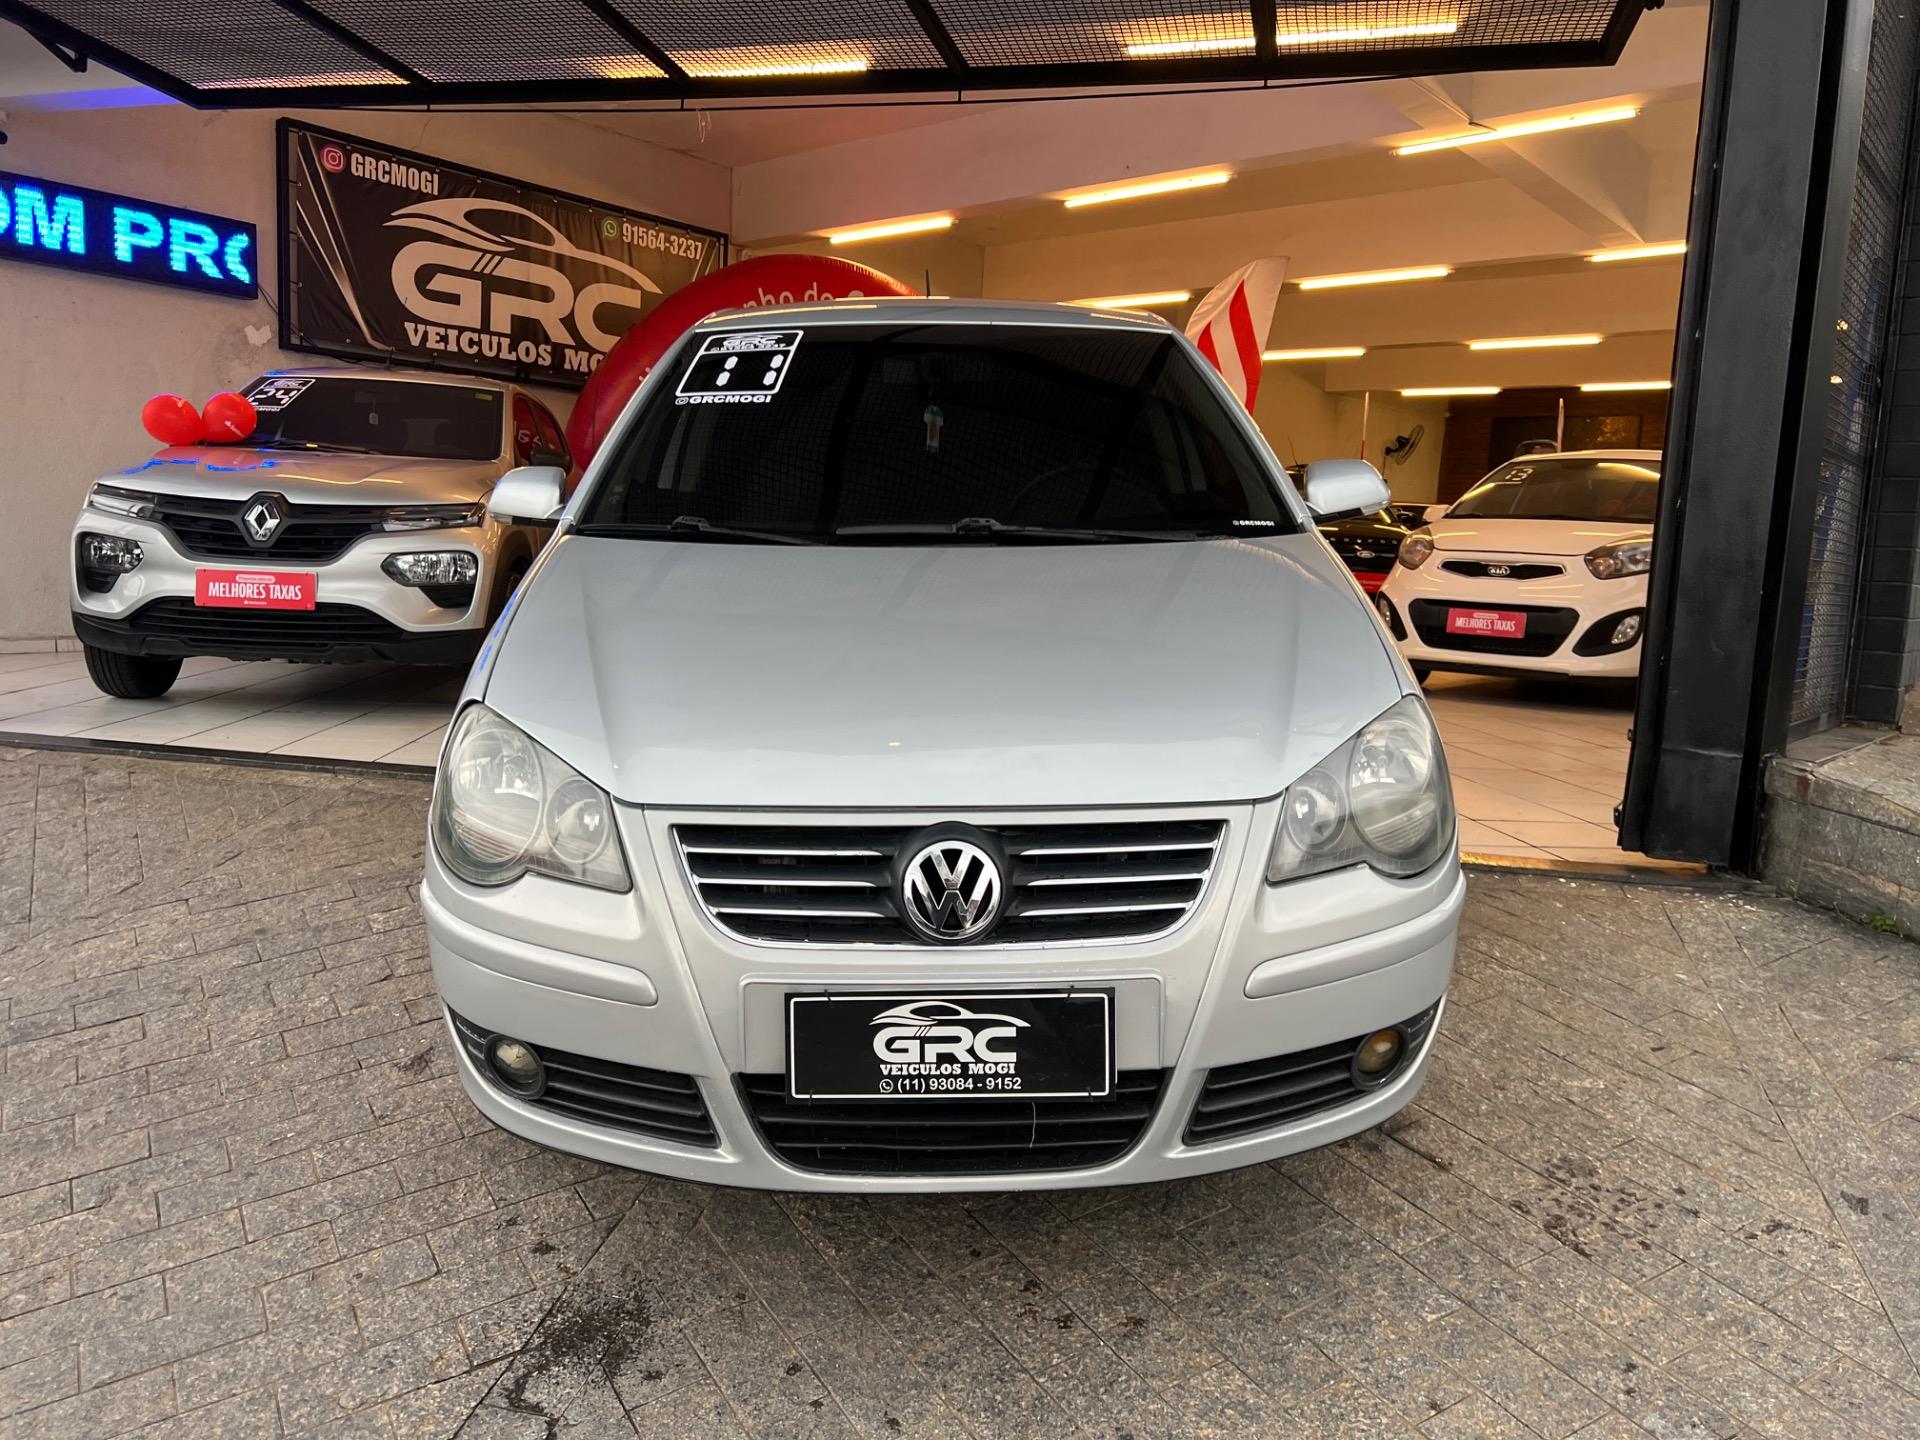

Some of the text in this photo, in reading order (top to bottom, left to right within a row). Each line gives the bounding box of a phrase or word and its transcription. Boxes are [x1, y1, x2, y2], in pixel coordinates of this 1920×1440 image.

[351, 153, 440, 196] GRCMOGI
[622, 222, 702, 261] 91564-3237
[391, 240, 642, 354] GRC
[404, 321, 553, 367] VEICULOS
[208, 582, 302, 601] MELHORES TAXAS
[1455, 617, 1516, 632] MELHORES TAXAS
[873, 1026, 1017, 1063] GRC
[880, 1063, 1016, 1076] VEICULOS MOGI
[897, 1078, 926, 1093] (11)
[929, 1078, 974, 1090] 93084
[986, 1077, 1021, 1091] 9152
